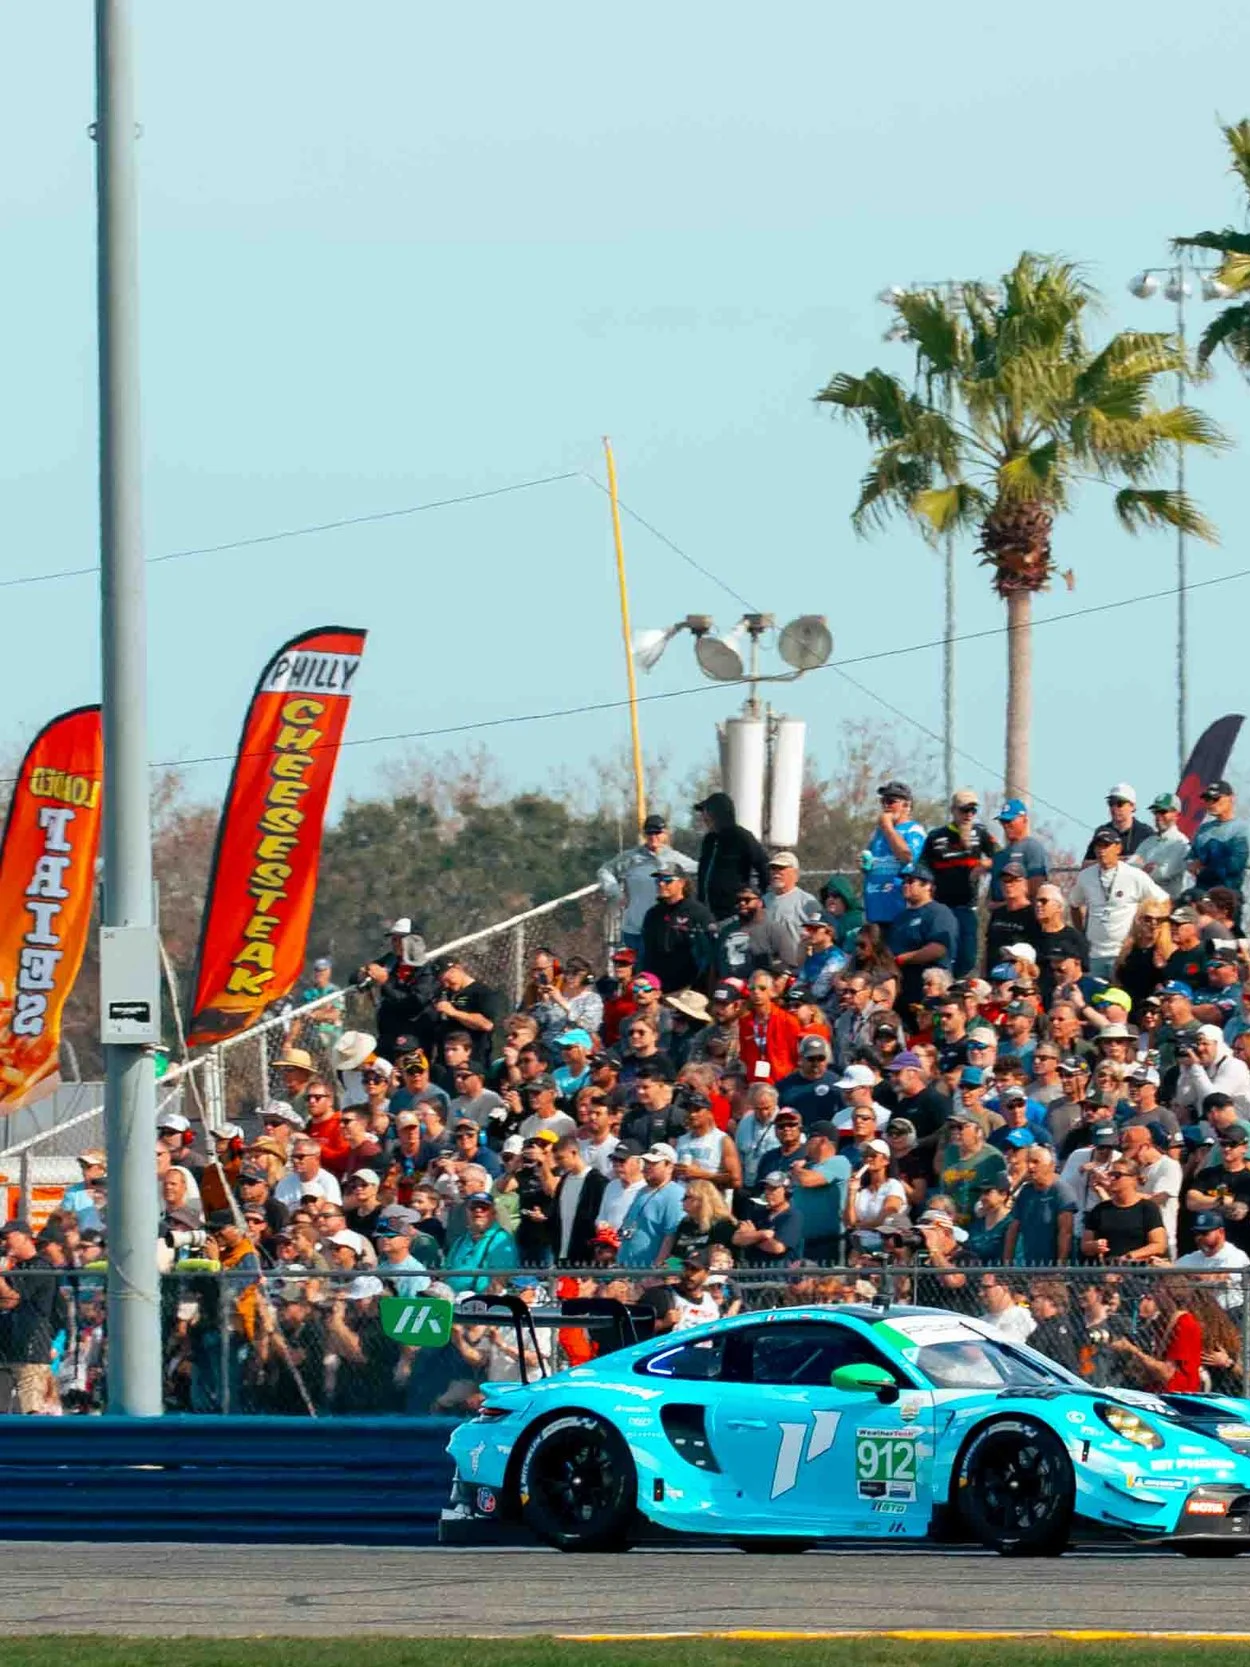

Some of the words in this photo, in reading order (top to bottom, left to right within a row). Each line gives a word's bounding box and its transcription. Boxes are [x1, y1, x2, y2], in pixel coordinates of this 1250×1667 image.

[272, 655, 359, 690] PHILLY
[226, 698, 326, 996] CHEESESTEAK
[858, 1429, 914, 1438] WeatherTech
[857, 1439, 915, 1480] 912
